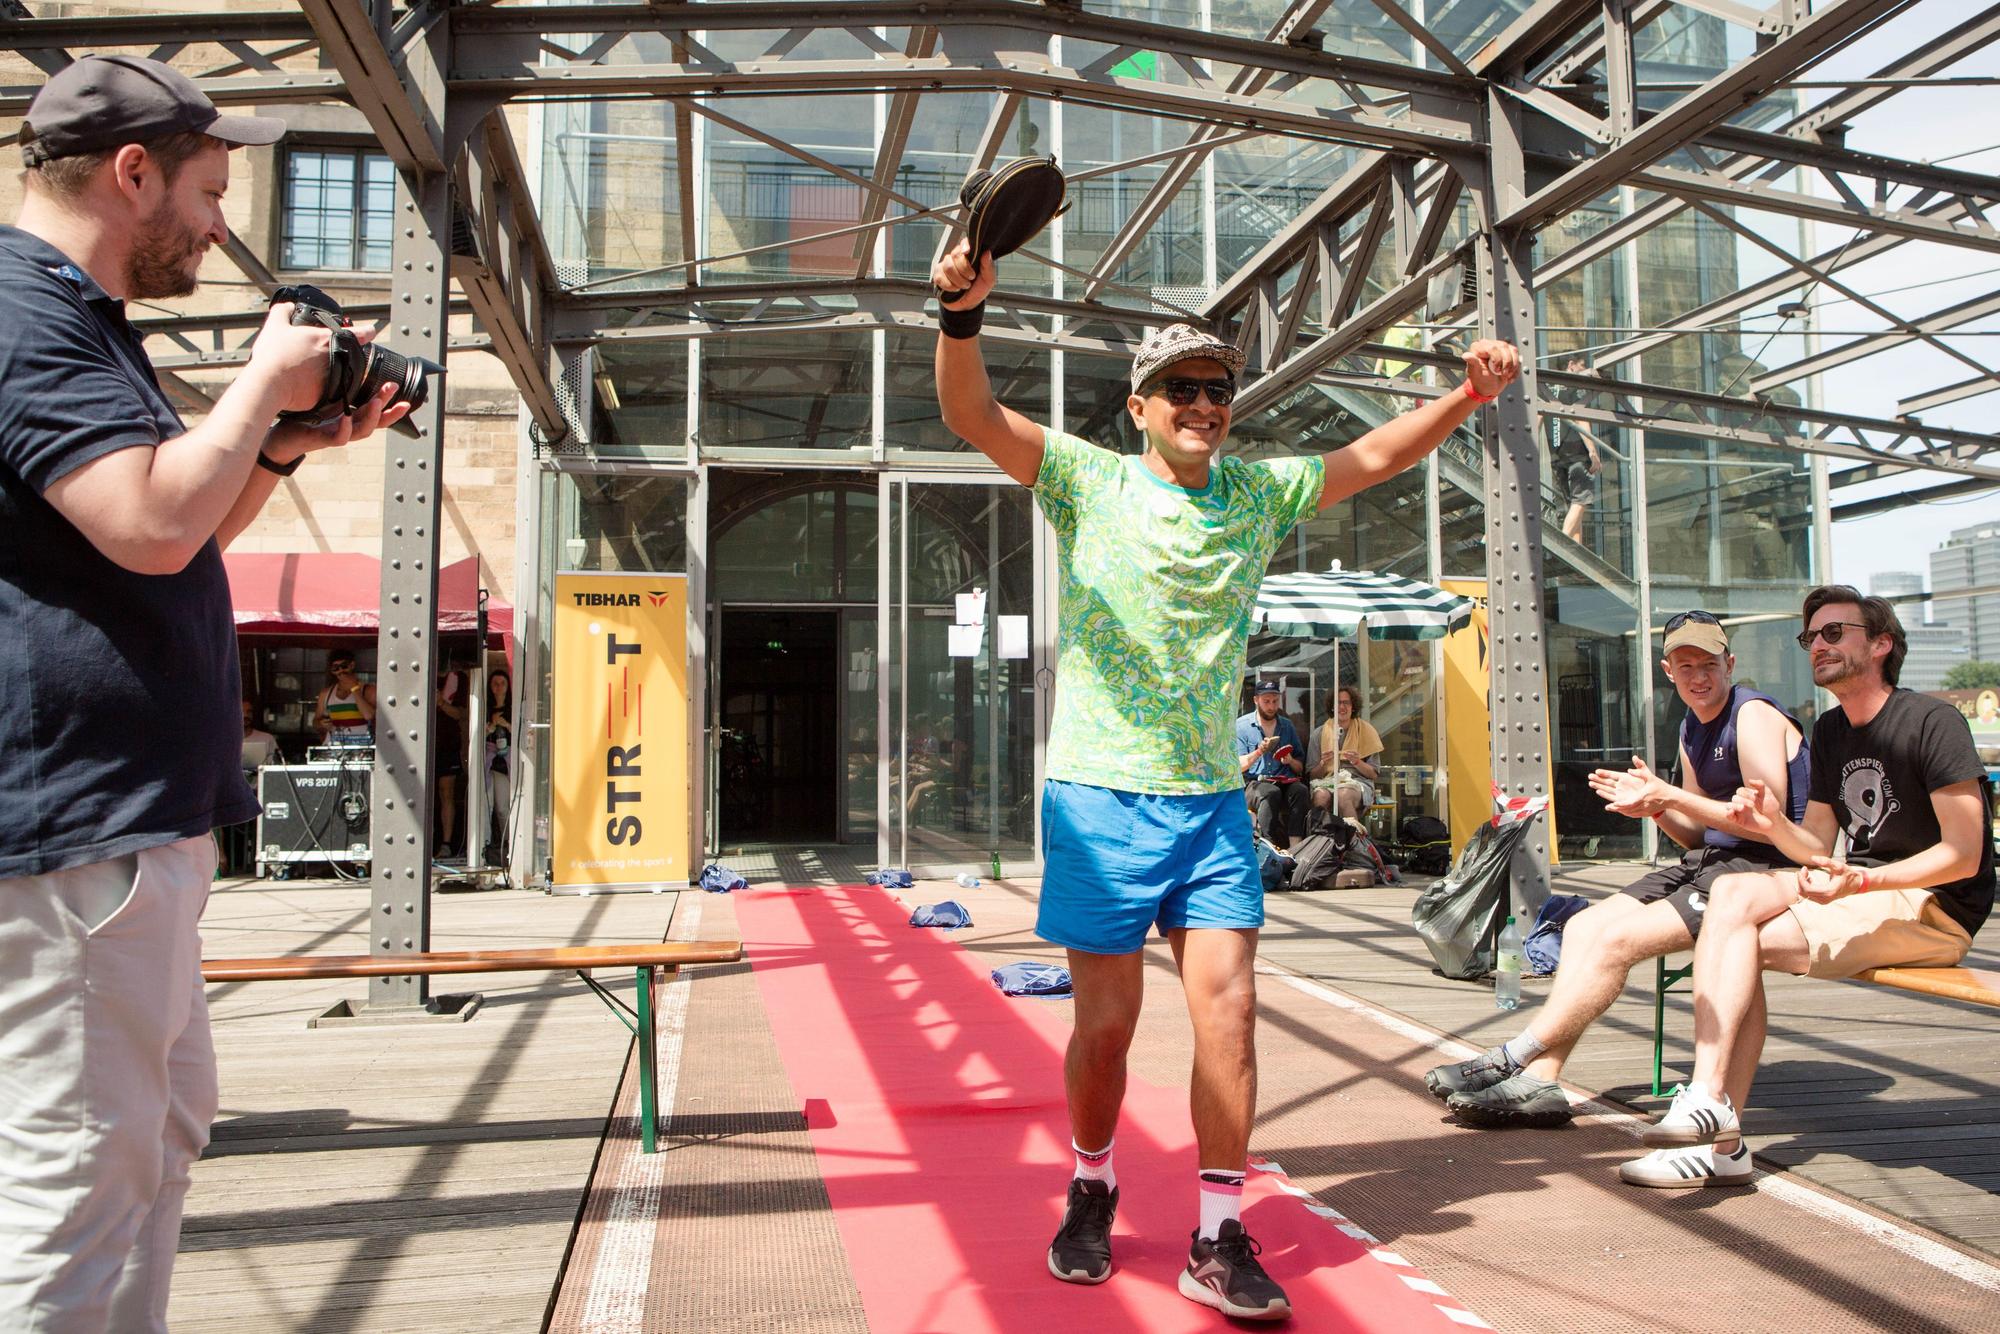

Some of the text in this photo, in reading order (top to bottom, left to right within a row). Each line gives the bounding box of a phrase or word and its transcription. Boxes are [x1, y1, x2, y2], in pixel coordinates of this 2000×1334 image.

[573, 593, 641, 607] TIBHAR
[296, 778, 314, 787] VPS
[627, 857, 641, 865] the
